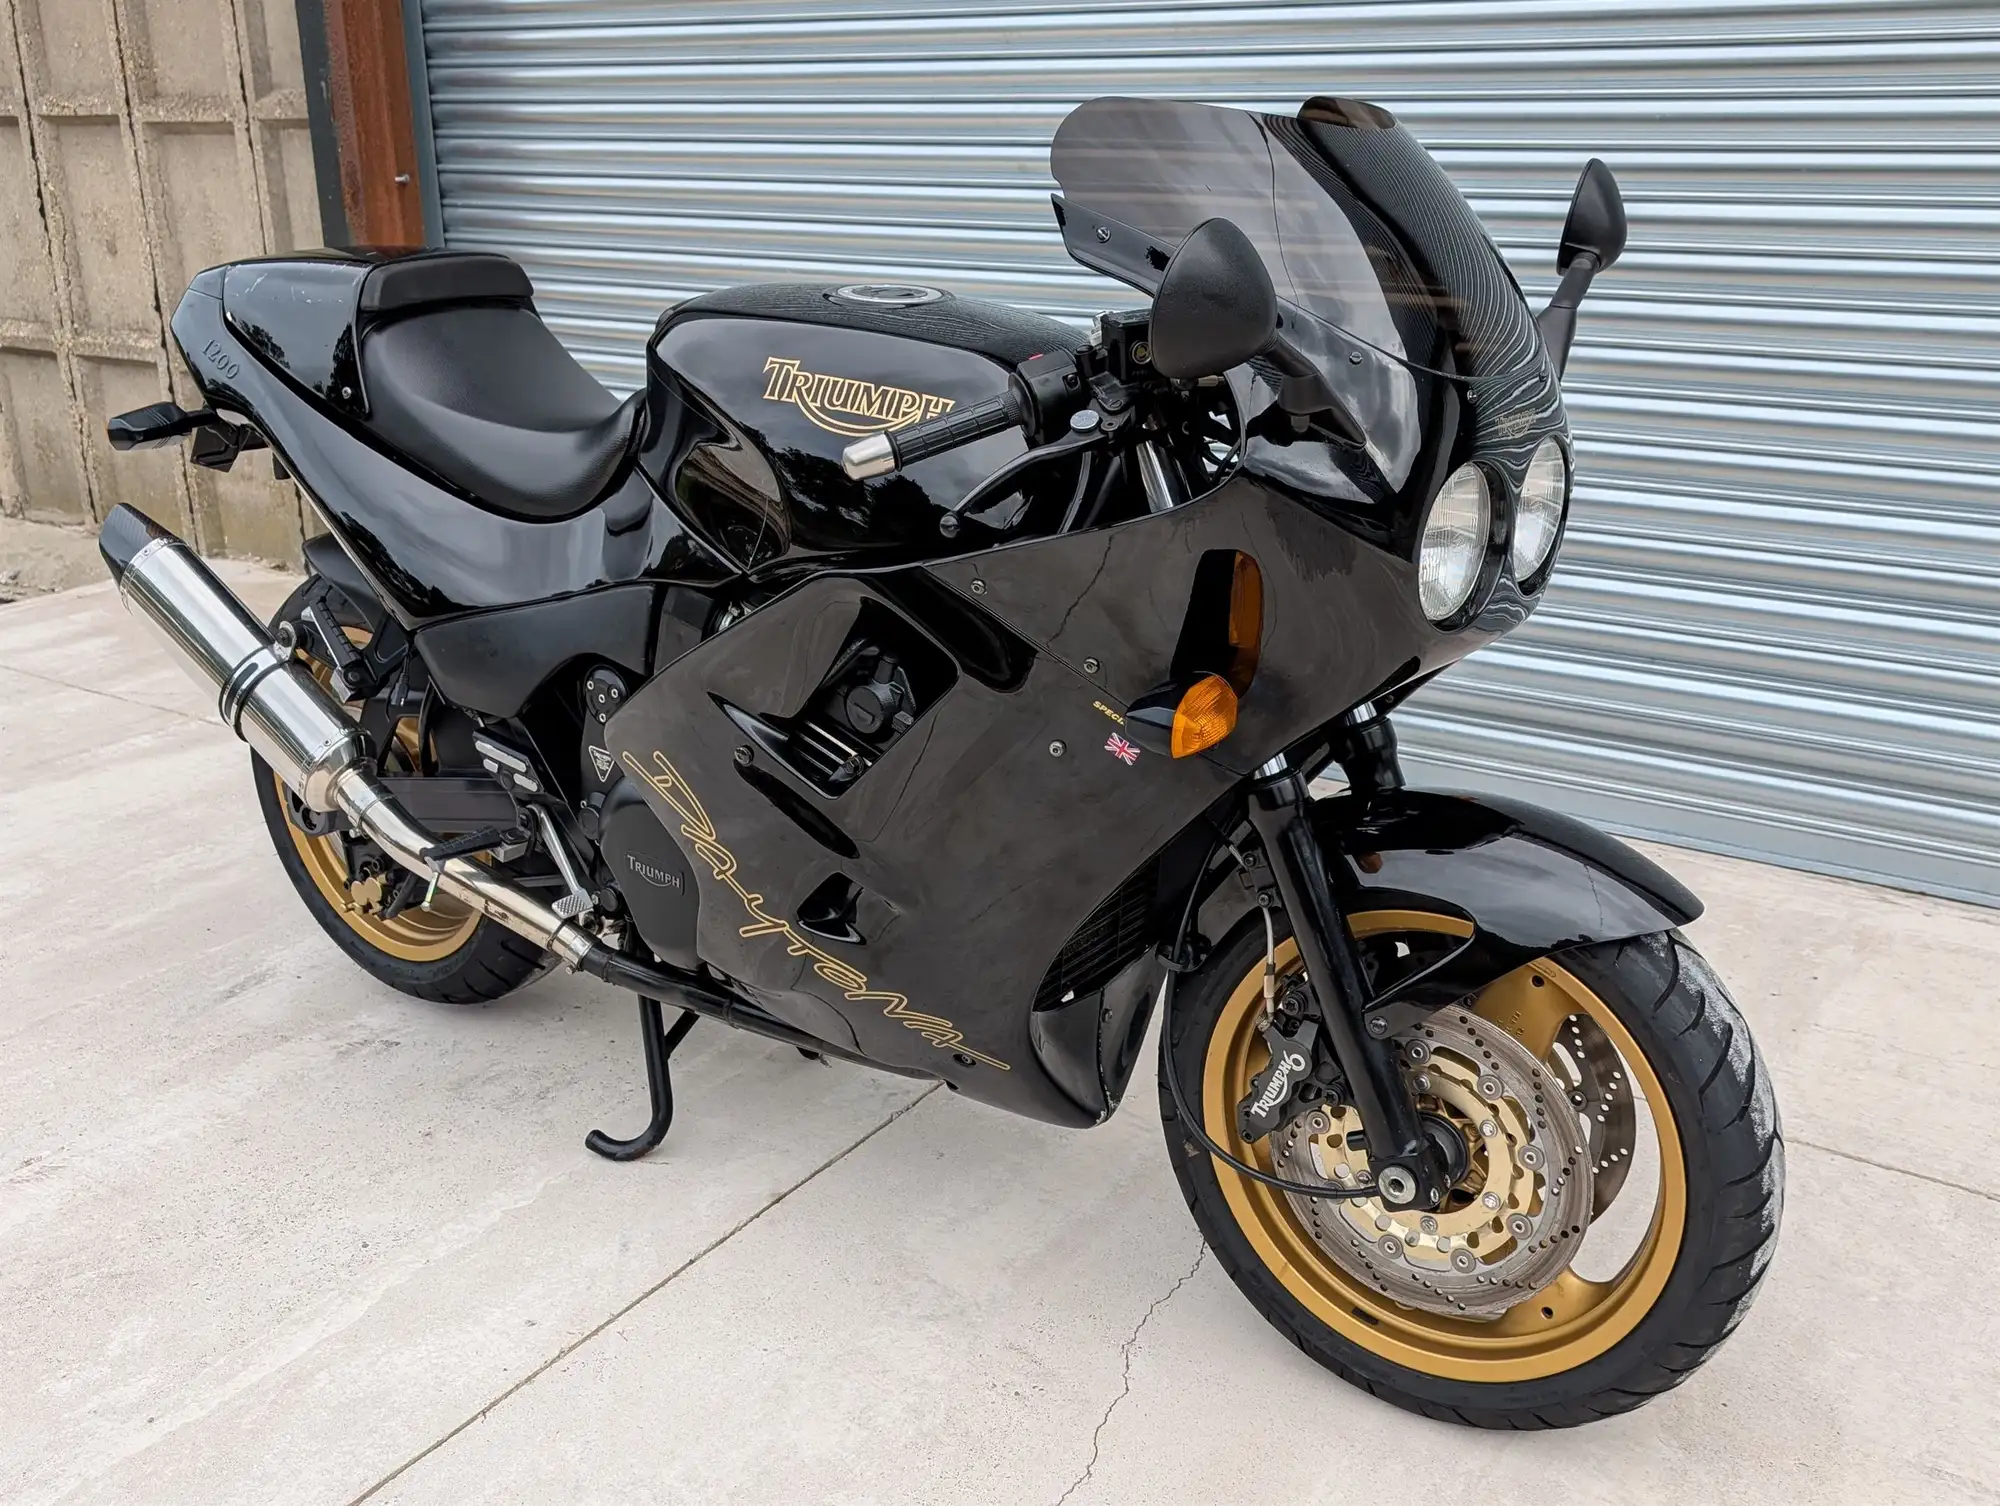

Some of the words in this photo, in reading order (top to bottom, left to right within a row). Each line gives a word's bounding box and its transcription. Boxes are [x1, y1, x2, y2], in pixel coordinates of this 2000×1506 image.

[199, 339, 241, 380] 1200
[762, 356, 956, 437] TRIUMPH
[1092, 700, 1126, 726] SPECI
[627, 854, 681, 889] TRIUMPH
[1250, 1059, 1292, 1118] TRIUMPH
